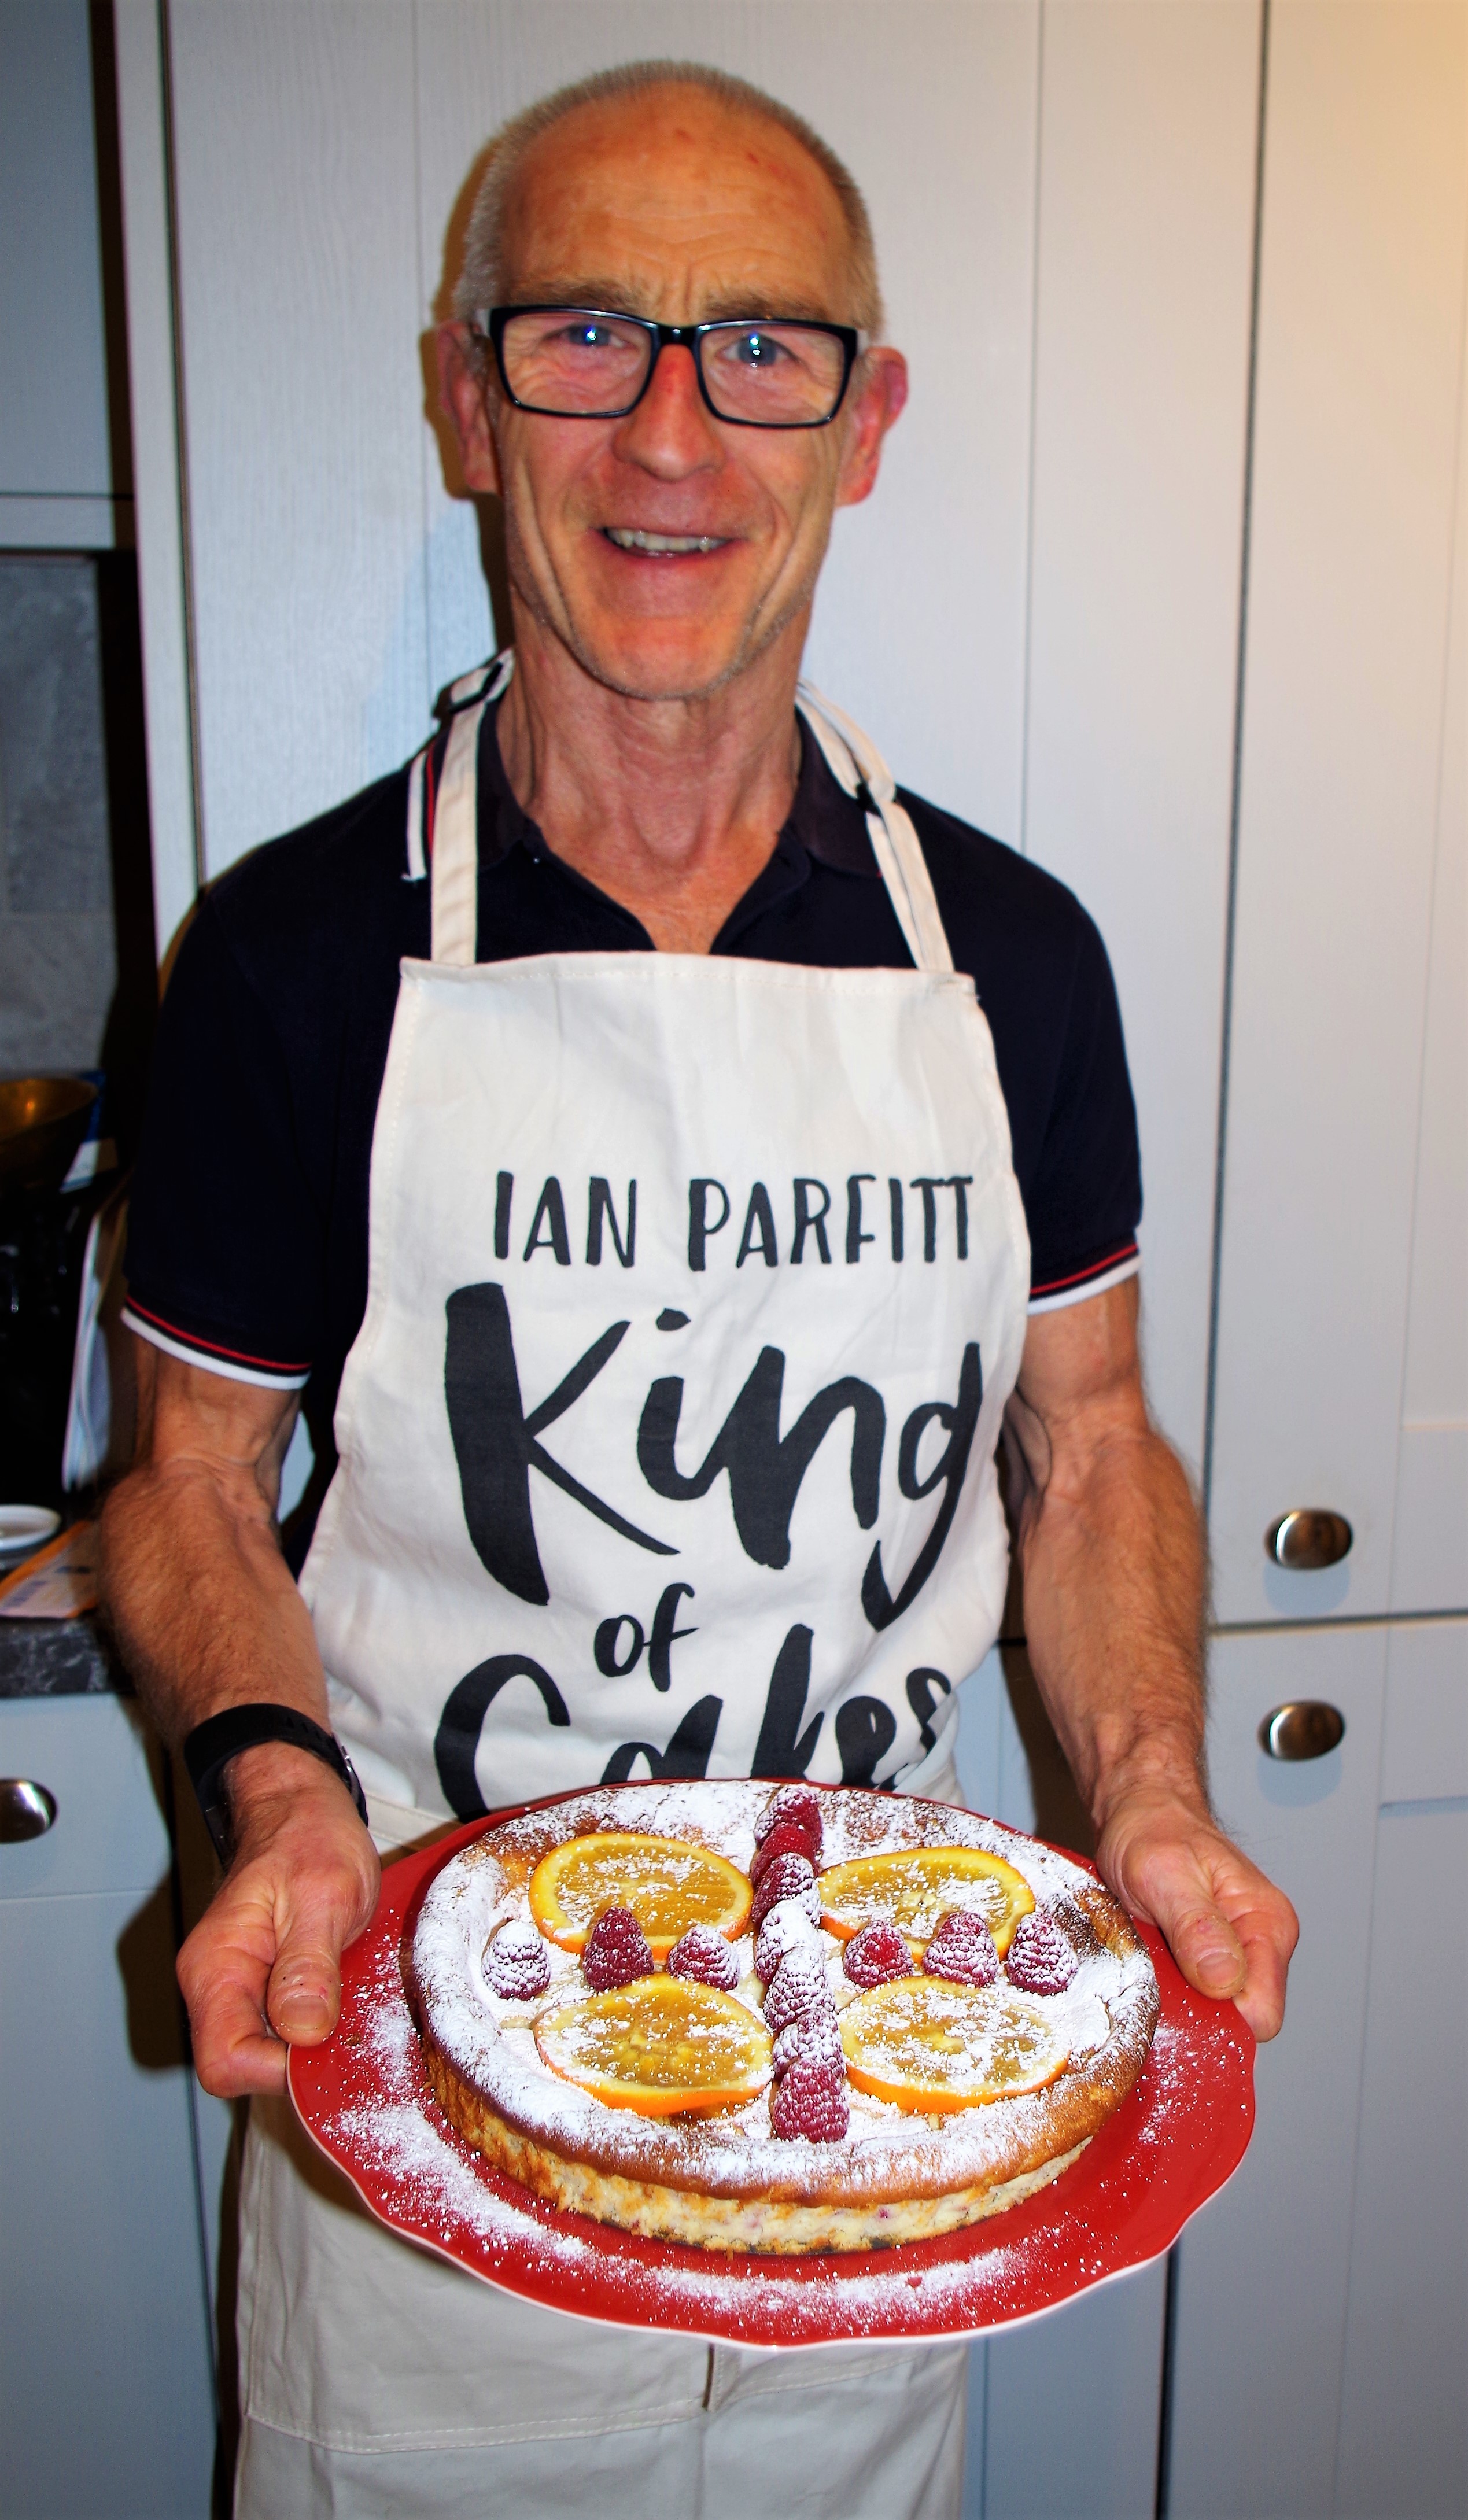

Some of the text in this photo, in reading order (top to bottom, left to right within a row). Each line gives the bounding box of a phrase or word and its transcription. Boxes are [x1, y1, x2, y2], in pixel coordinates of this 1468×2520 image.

[494, 1171, 973, 1271] IAN PARFITT
[444, 1282, 983, 1633] King
[593, 1582, 699, 1692] of
